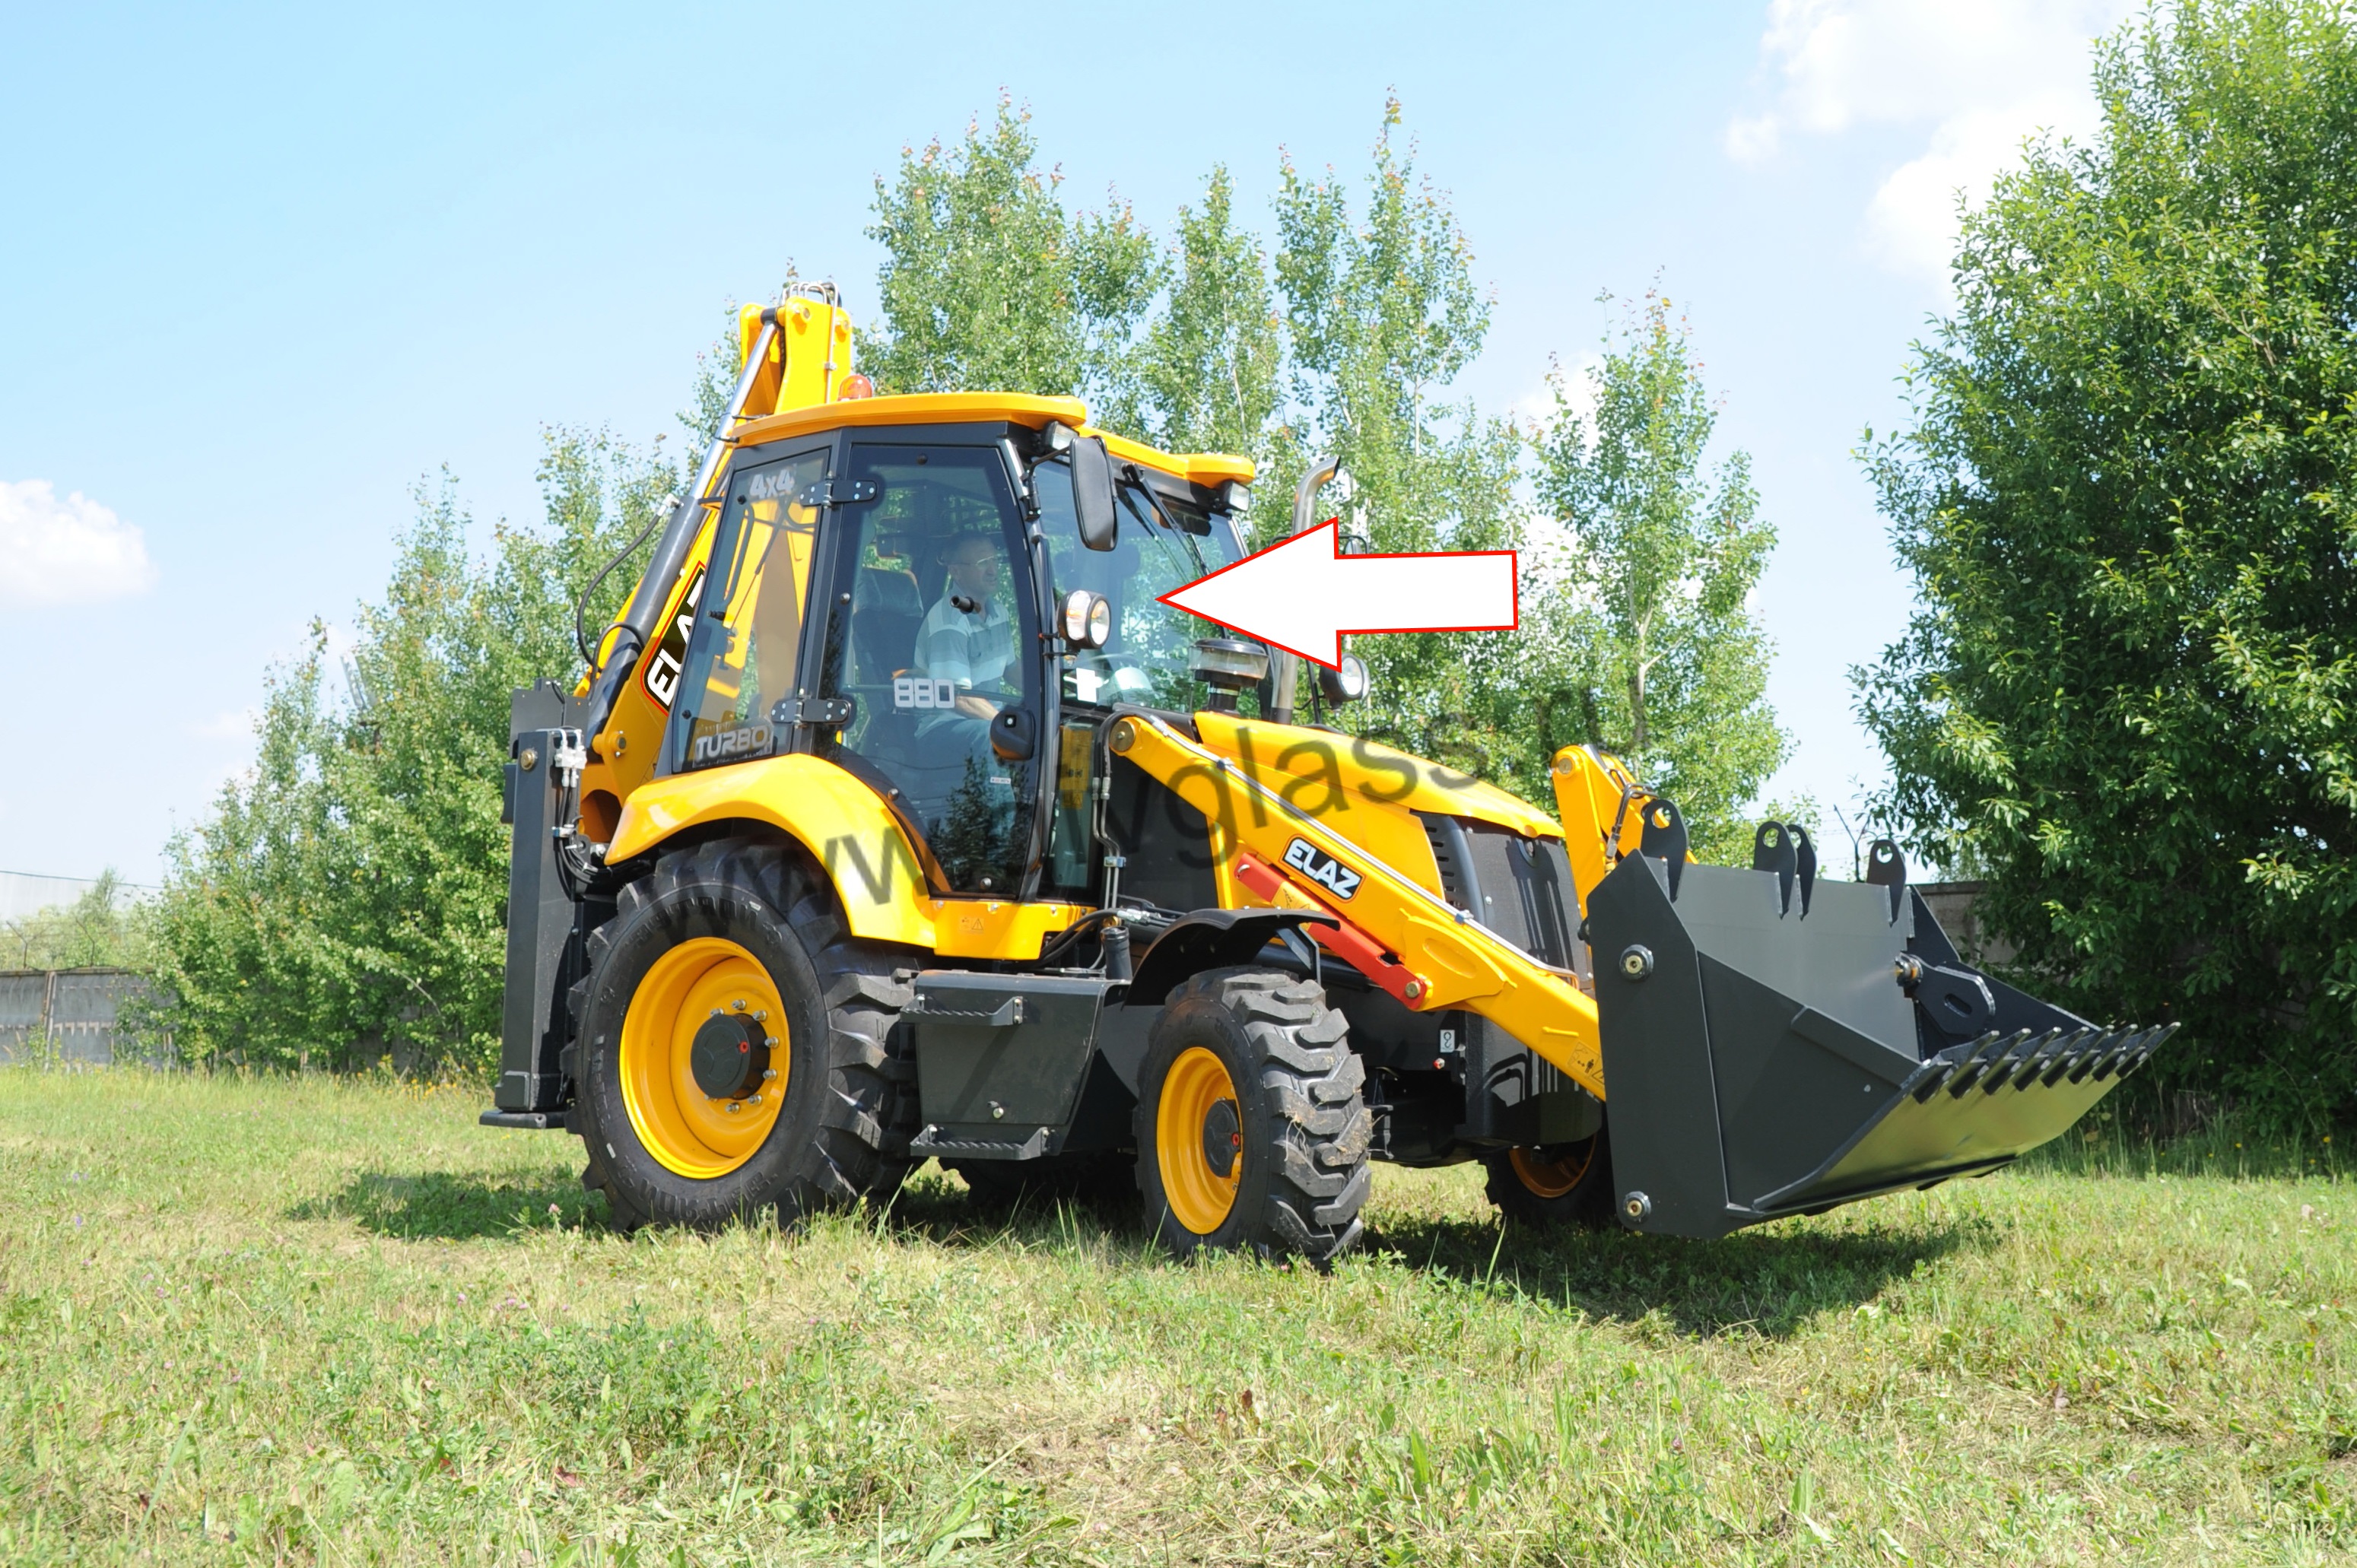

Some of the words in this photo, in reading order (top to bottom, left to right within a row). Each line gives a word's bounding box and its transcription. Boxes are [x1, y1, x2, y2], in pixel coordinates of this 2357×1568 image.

[749, 468, 796, 500] 4x4
[894, 678, 955, 709] 880
[696, 725, 768, 762] TURBO
[1284, 838, 1361, 899] ELAZ
